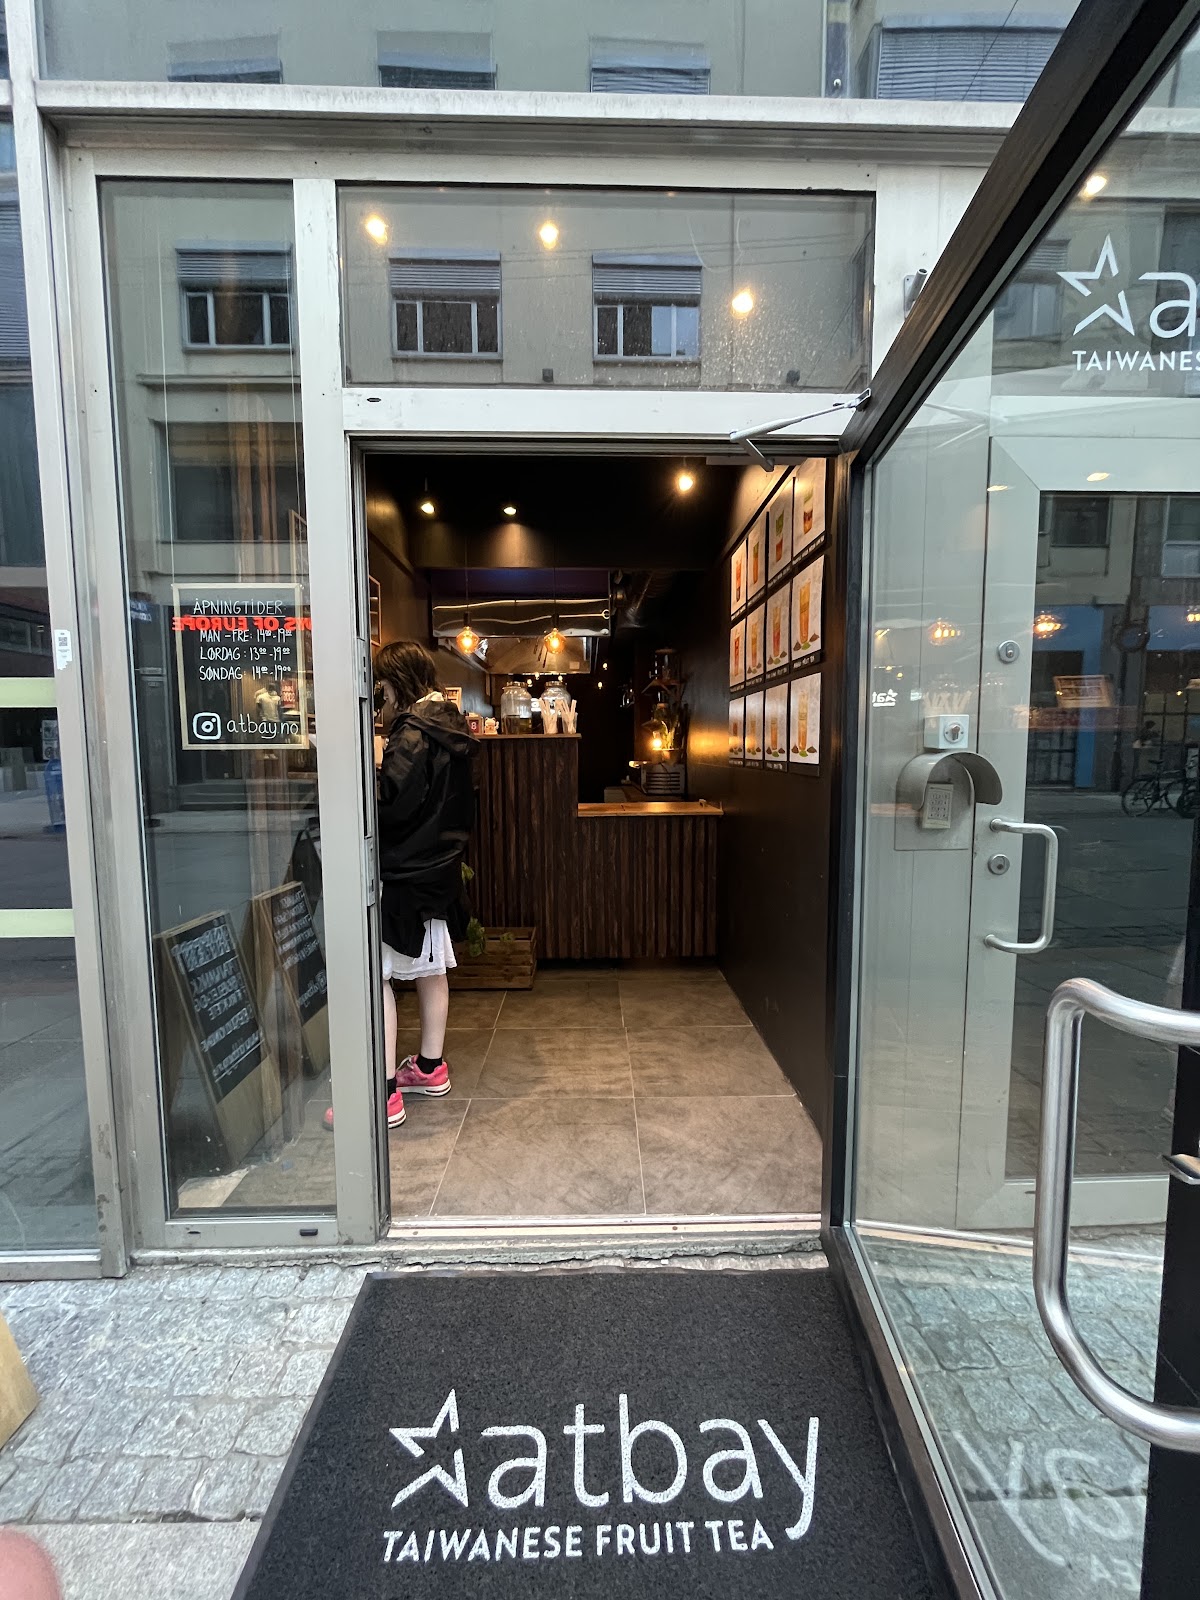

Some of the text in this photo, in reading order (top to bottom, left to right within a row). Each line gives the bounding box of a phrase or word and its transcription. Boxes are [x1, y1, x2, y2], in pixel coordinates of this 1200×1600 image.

[200, 629, 221, 643] MAN
[481, 1393, 819, 1541] atbay
[383, 1518, 775, 1563] TAIWANESE FRUIT TEA
